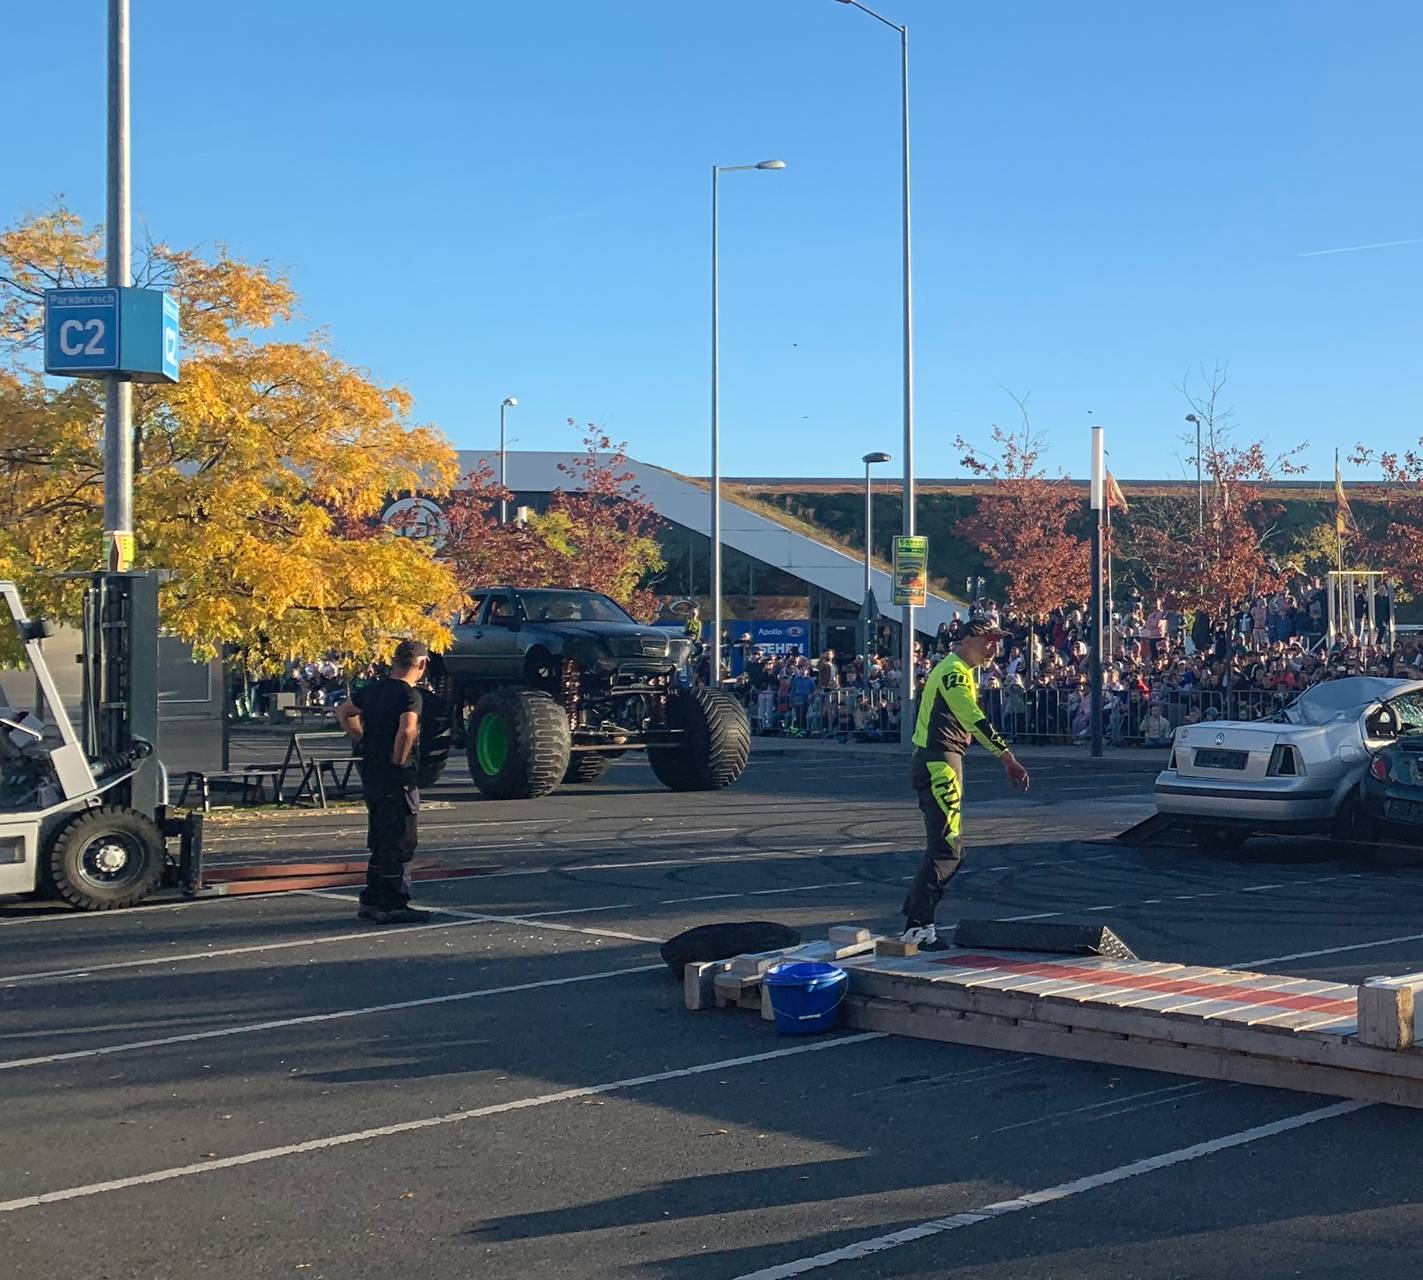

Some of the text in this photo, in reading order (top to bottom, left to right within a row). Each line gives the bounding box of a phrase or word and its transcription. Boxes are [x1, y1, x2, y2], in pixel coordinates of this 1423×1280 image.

[50, 294, 114, 305] Parkbereich
[60, 318, 105, 356] C2
[758, 628, 783, 636] Apollo
